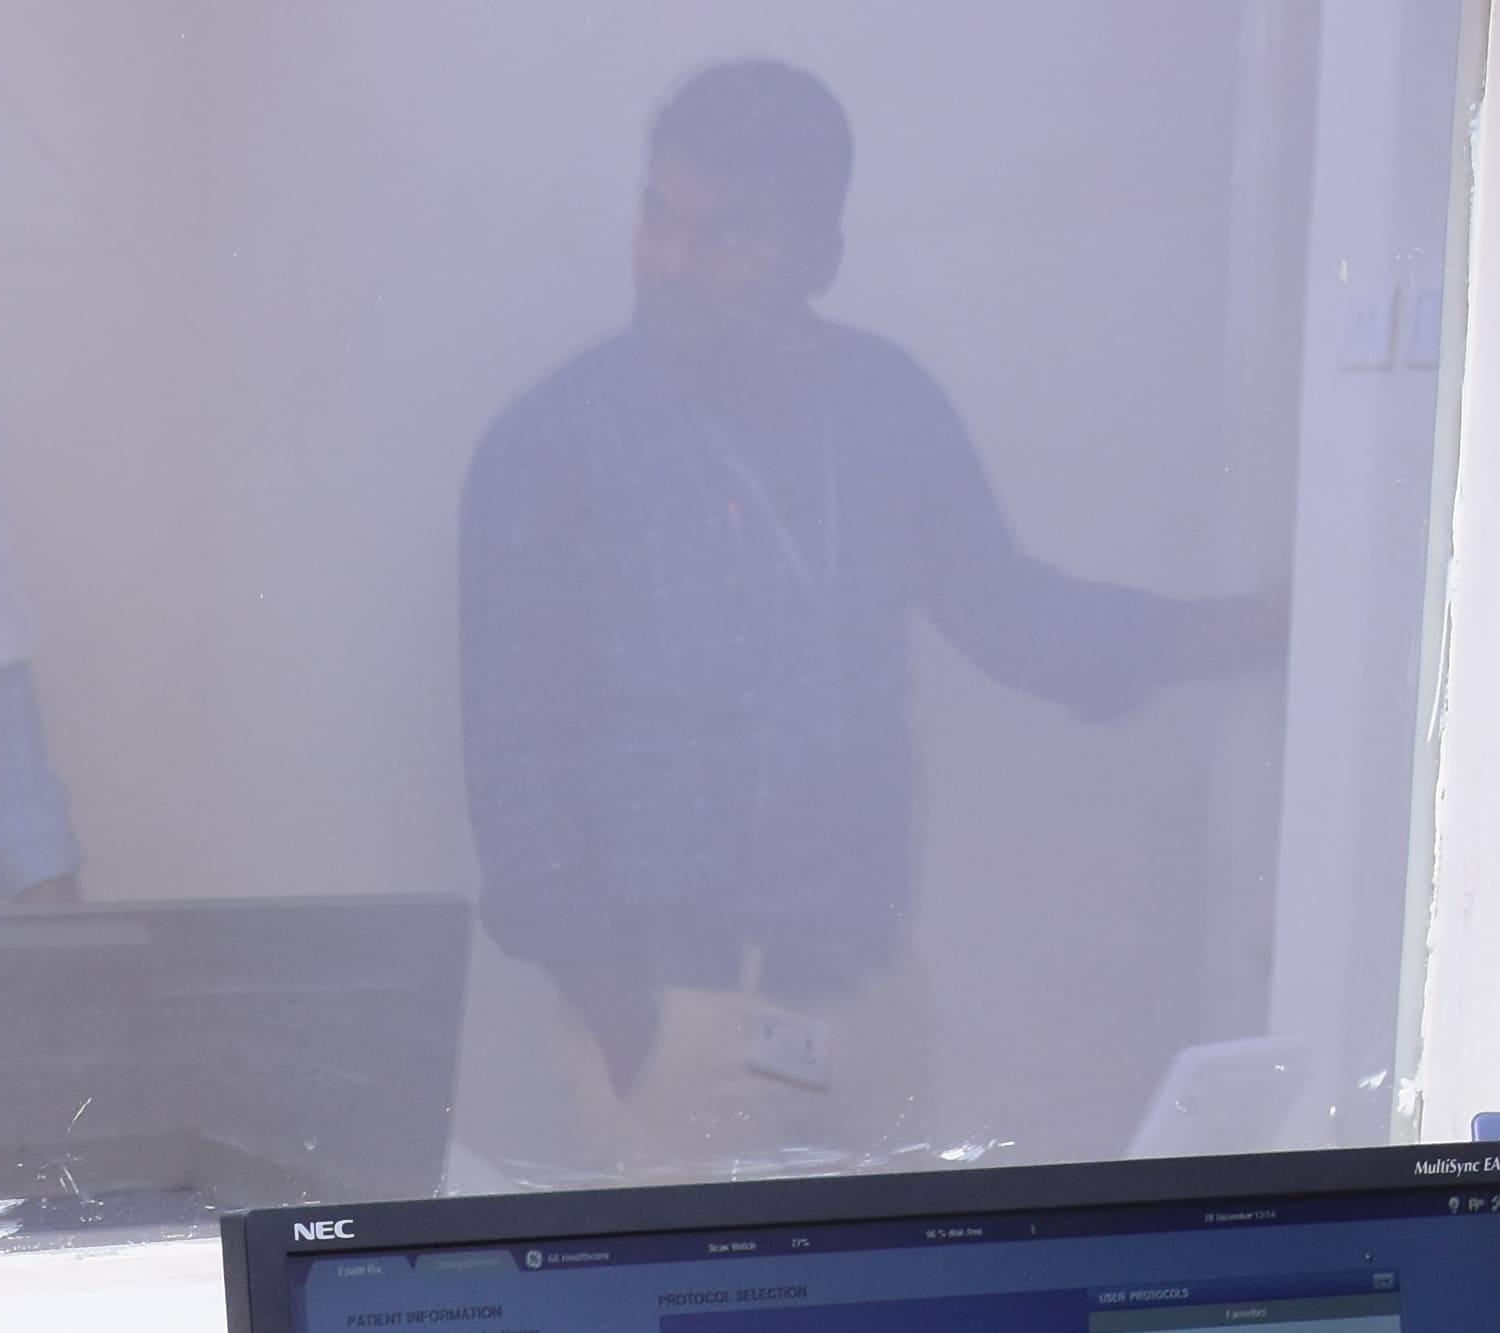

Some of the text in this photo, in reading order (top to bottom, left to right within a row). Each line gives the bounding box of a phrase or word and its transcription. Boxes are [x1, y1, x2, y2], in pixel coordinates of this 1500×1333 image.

[1414, 1158, 1480, 1178] MultiSync
[293, 1219, 356, 1242] NEC
[657, 1284, 810, 1307] PROTOCOL SELECTION
[1098, 1286, 1190, 1304] USER PROTOCOLS
[346, 1306, 504, 1329] PATIENT INFORMATION
